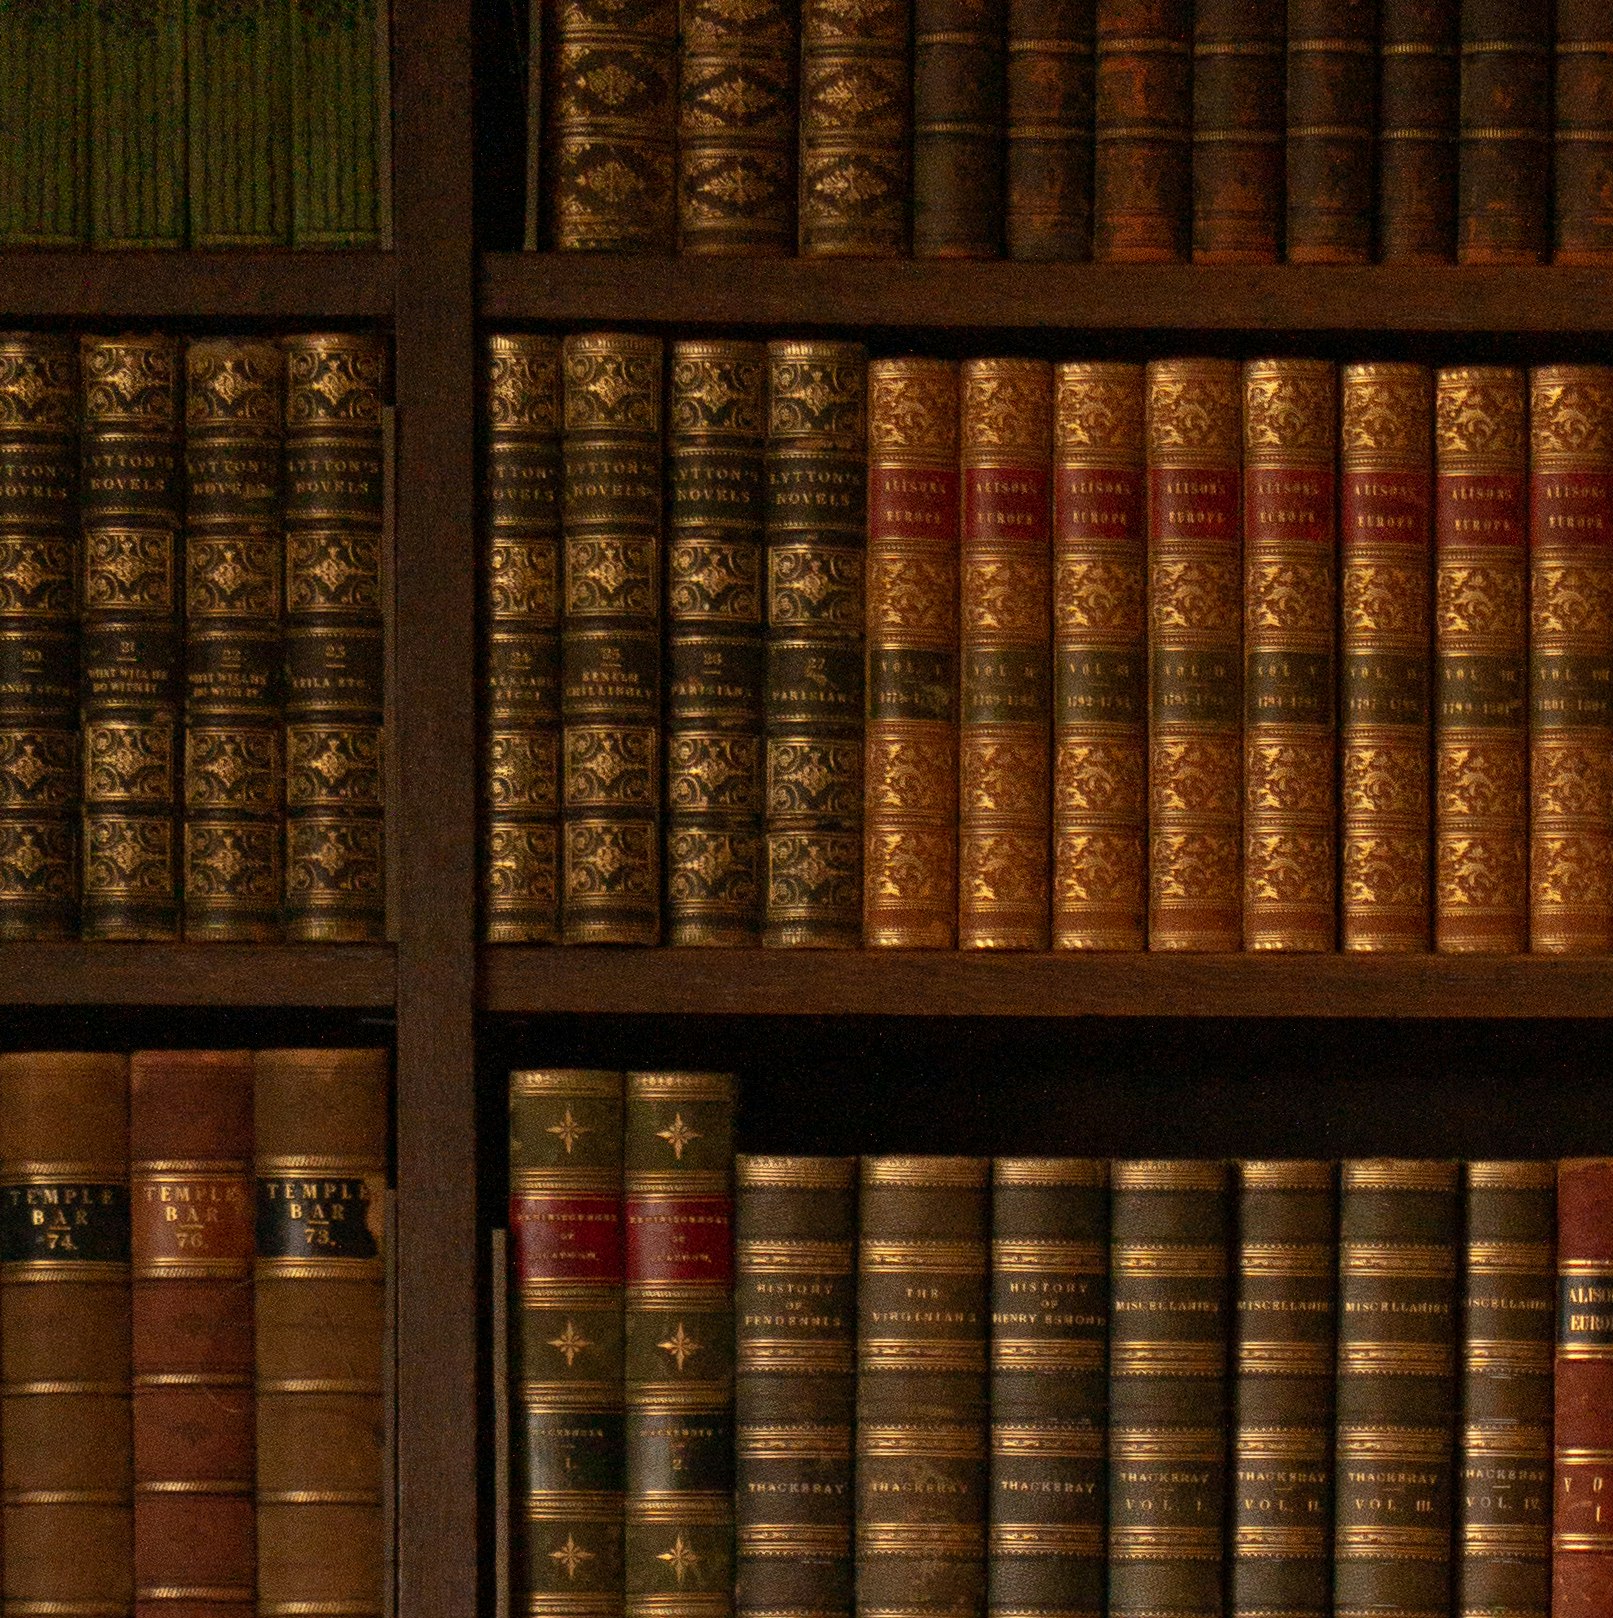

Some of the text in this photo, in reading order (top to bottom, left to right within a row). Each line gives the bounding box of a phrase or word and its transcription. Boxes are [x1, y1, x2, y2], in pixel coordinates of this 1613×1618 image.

[90, 478, 165, 492] NOVELS
[294, 480, 369, 494] NOVELS
[573, 483, 648, 497] NOVELS
[676, 488, 750, 502] NOVELS
[775, 492, 850, 506] NOVELS
[31, 1210, 89, 1226] BAR
[165, 1206, 219, 1222] BAR
[290, 1203, 345, 1220] BAR
[757, 1284, 834, 1295] HISTORY
[906, 1288, 939, 1299] THE
[1009, 1282, 1088, 1294] HISTORY
[1115, 1300, 1219, 1313] MISCELLANIES
[1345, 1302, 1448, 1314] MISCELLANIES
[872, 1312, 977, 1323] VIRGINIANS
[993, 1313, 1037, 1325] HENRY
[1120, 1472, 1209, 1483] THACKERAY
[1238, 1471, 1327, 1483] THACKERAY
[1349, 1472, 1438, 1485] THACKERAY
[748, 1482, 844, 1495] THACKERAY
[872, 1483, 969, 1494] THACKERAY
[1001, 1481, 1095, 1495] THACKERAY
